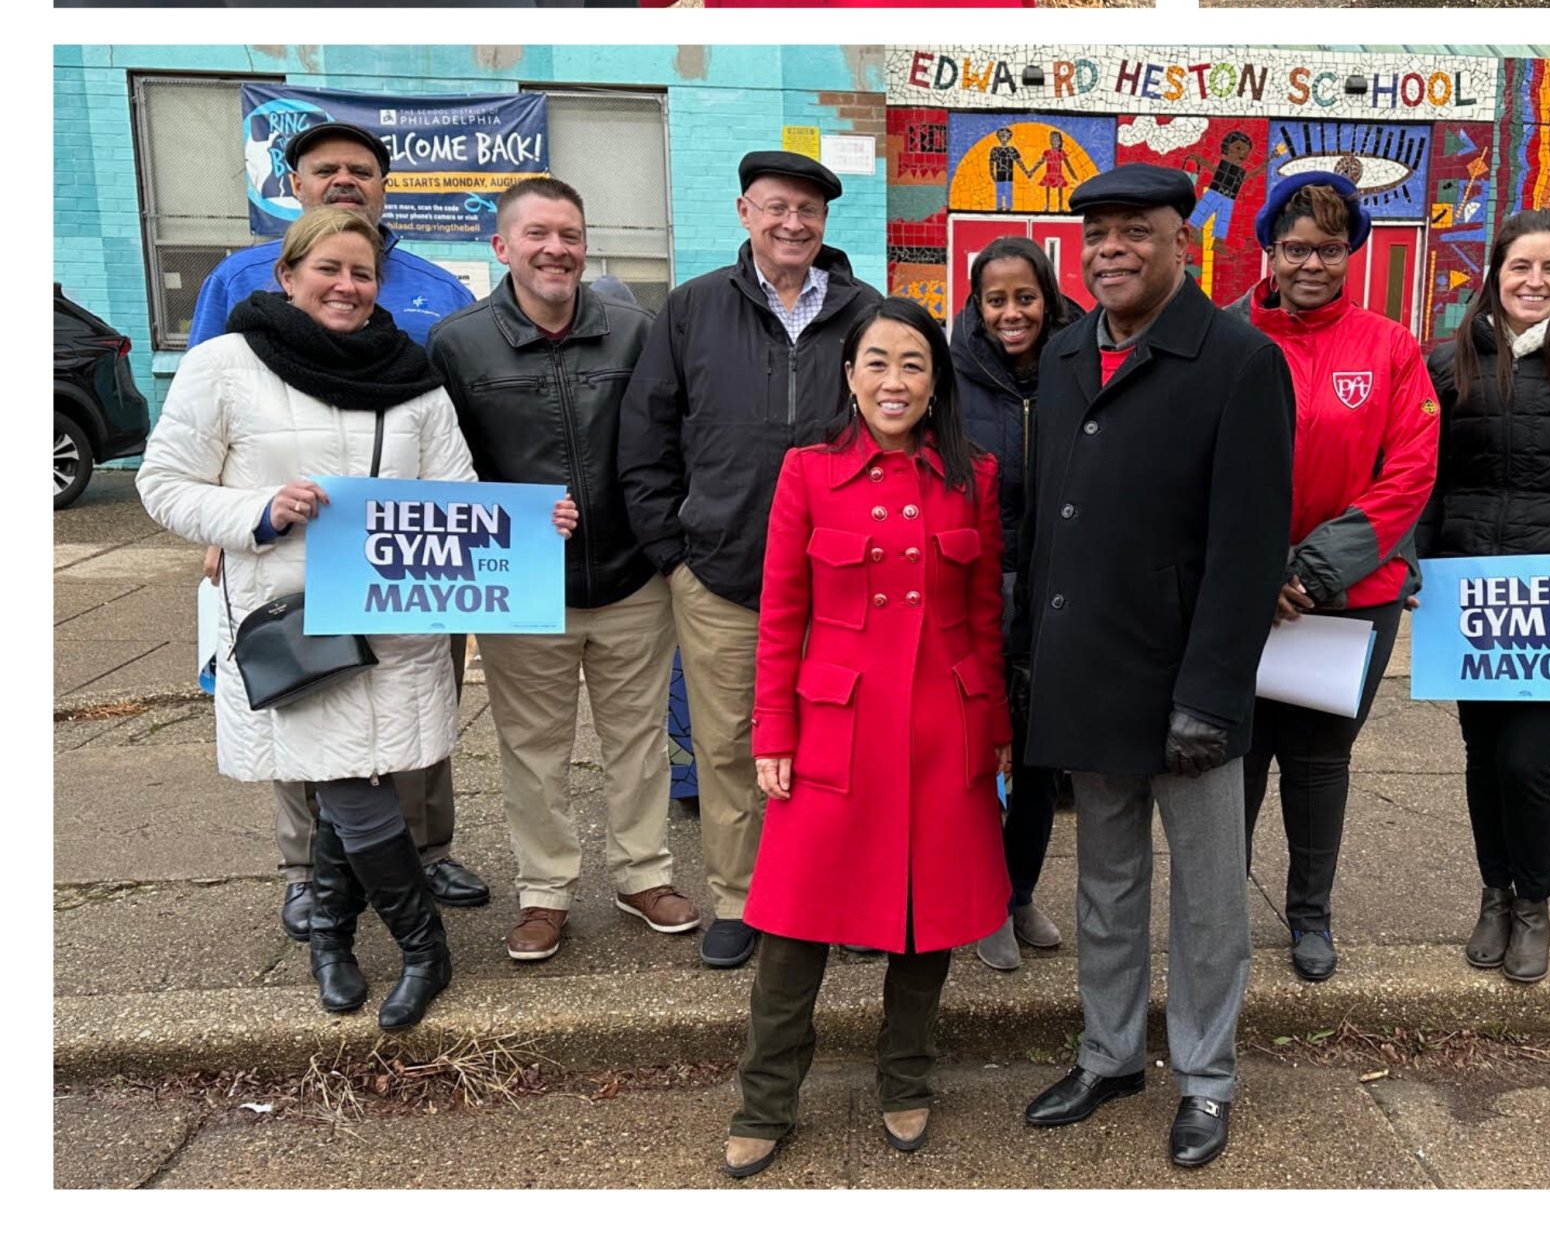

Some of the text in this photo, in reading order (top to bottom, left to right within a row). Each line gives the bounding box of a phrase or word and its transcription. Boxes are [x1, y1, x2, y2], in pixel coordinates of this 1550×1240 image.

[909, 51, 1477, 109] EDWARD HESTON SCHOOL
[400, 115, 502, 125] PHILADELPHIA
[381, 131, 542, 166] ELCOME BACK!
[402, 177, 440, 188] STARTS
[443, 177, 488, 189] MONDAY,
[491, 177, 521, 188] AUGU
[387, 222, 480, 233] hilasd.org/ringthebell
[410, 212, 433, 220] phone's
[1337, 376, 1370, 407] pft
[365, 499, 505, 538] HELEN
[364, 532, 510, 573] GYM FOR
[364, 583, 511, 613] MAYOR
[1459, 608, 1546, 638] GYM
